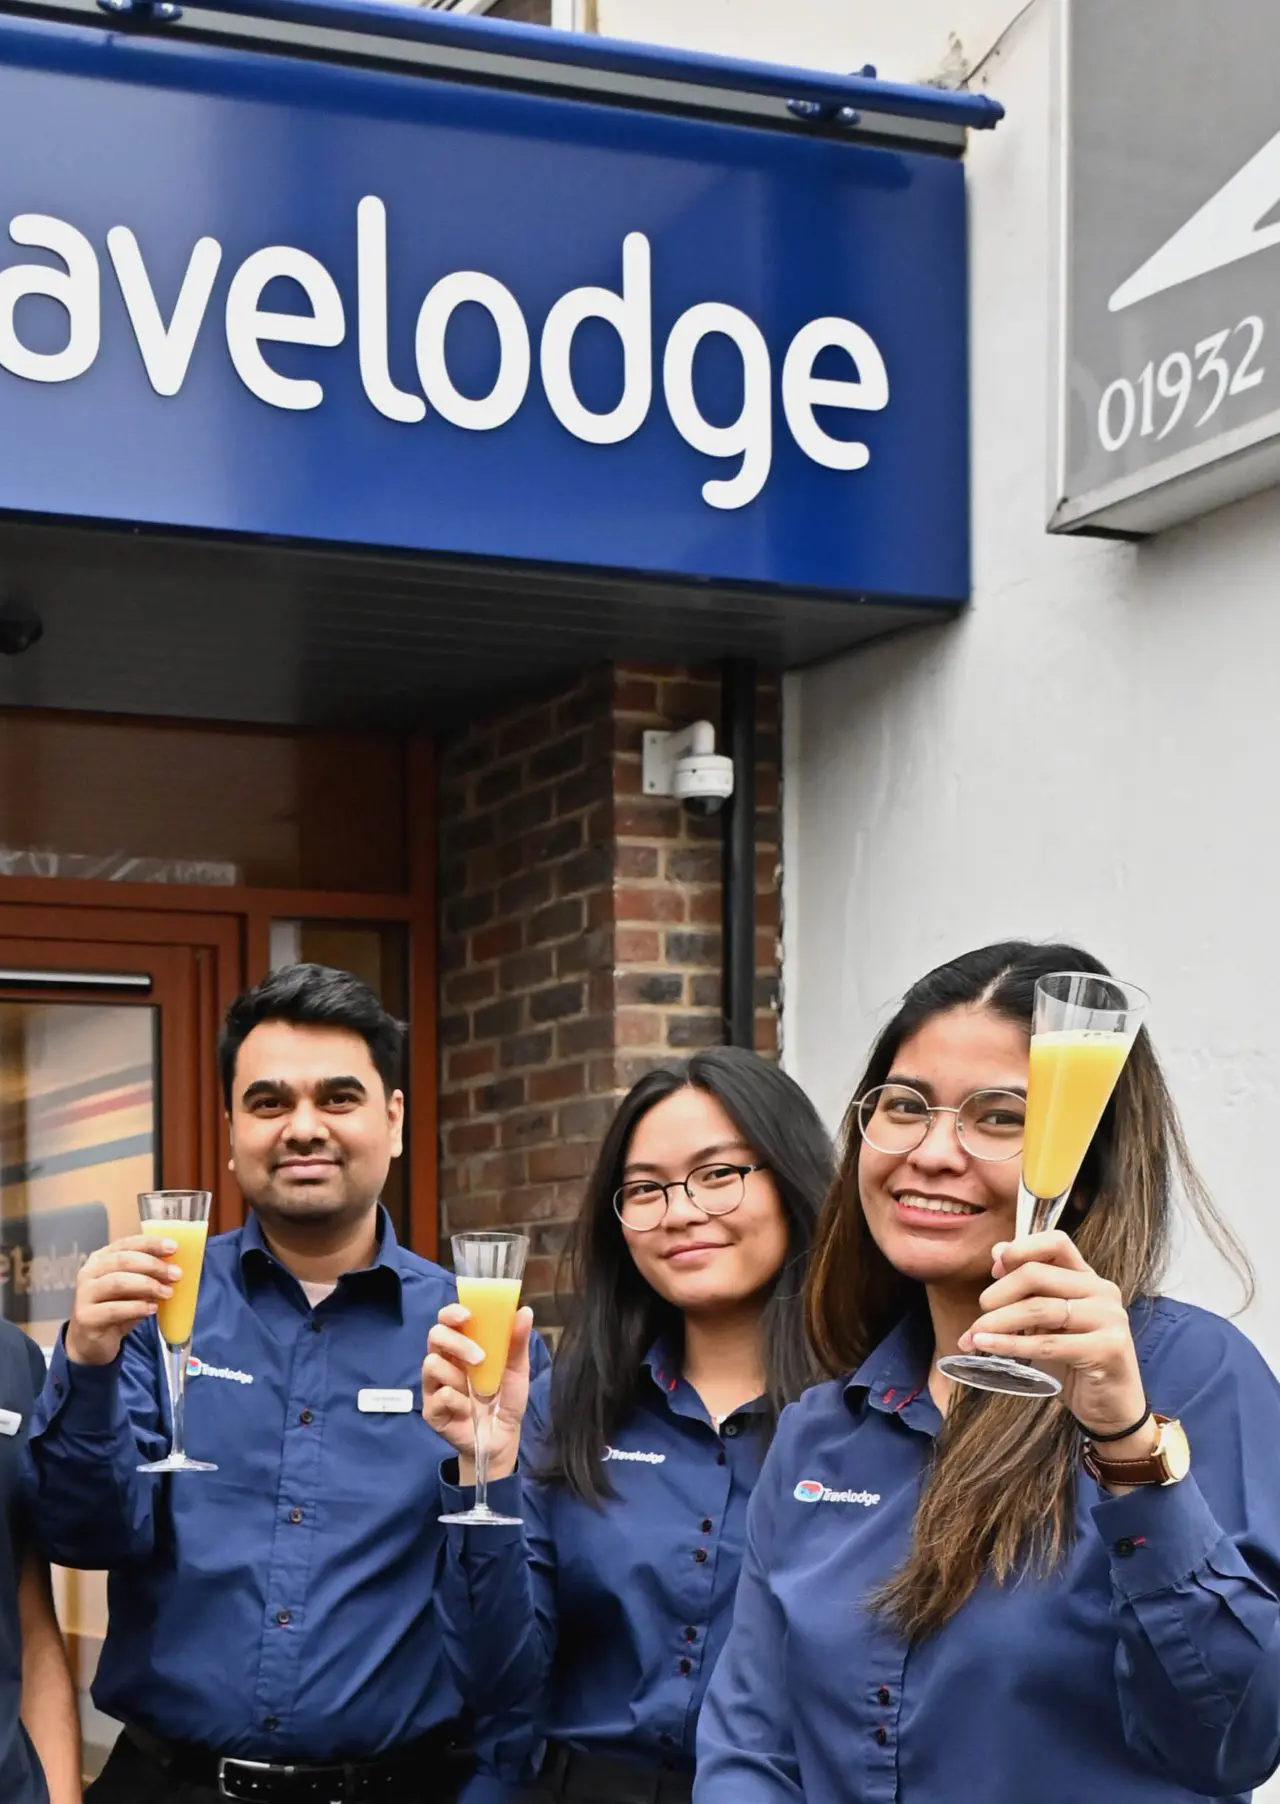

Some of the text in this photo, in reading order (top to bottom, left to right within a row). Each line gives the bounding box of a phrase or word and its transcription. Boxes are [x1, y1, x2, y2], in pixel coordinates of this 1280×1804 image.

[1097, 315, 1265, 452] 01932
[202, 1363, 254, 1384] Travelodge
[610, 1448, 666, 1464] Travelodge
[822, 1488, 881, 1507] Travelodge
